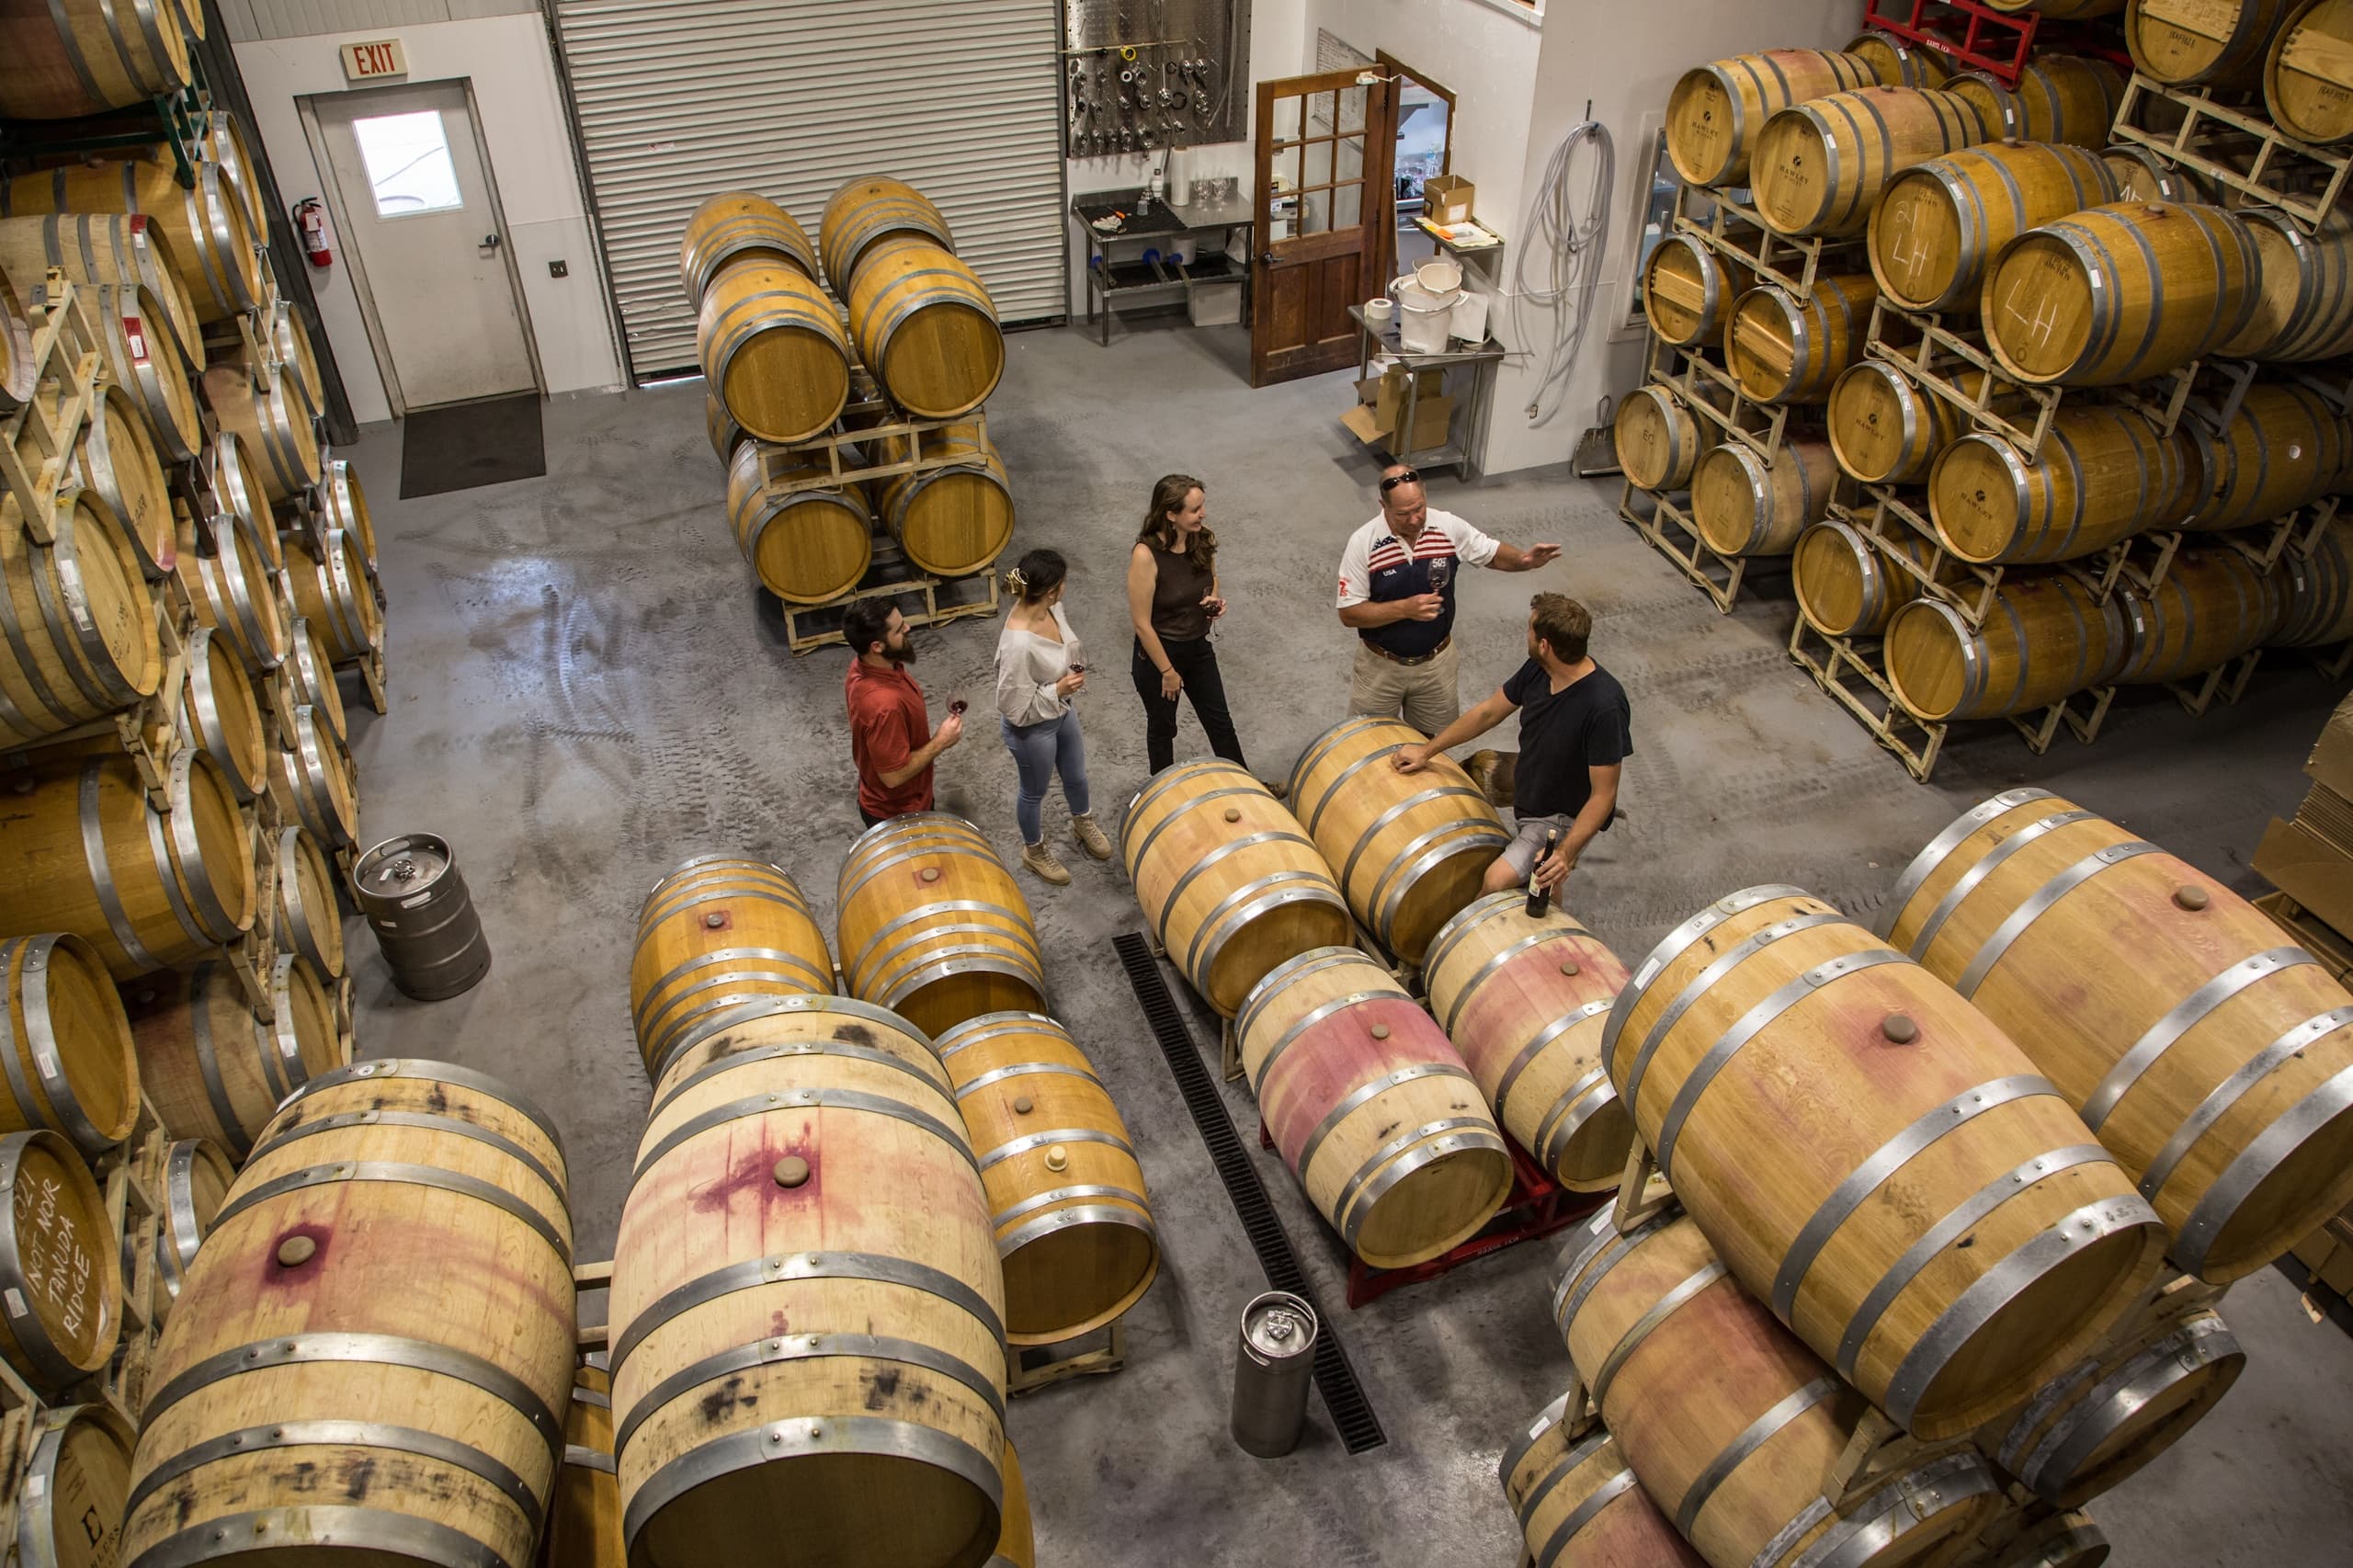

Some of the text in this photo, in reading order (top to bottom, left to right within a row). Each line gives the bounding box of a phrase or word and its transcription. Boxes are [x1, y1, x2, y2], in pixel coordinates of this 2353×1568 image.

[352, 43, 395, 75] EXIT
[1892, 232, 1929, 278] LH
[2005, 278, 2058, 348] LH
[1382, 569, 1397, 577] USA
[37, 1177, 61, 1234] NOIR
[48, 1214, 74, 1307] TANUDA
[63, 1244, 90, 1339] RIDGE
